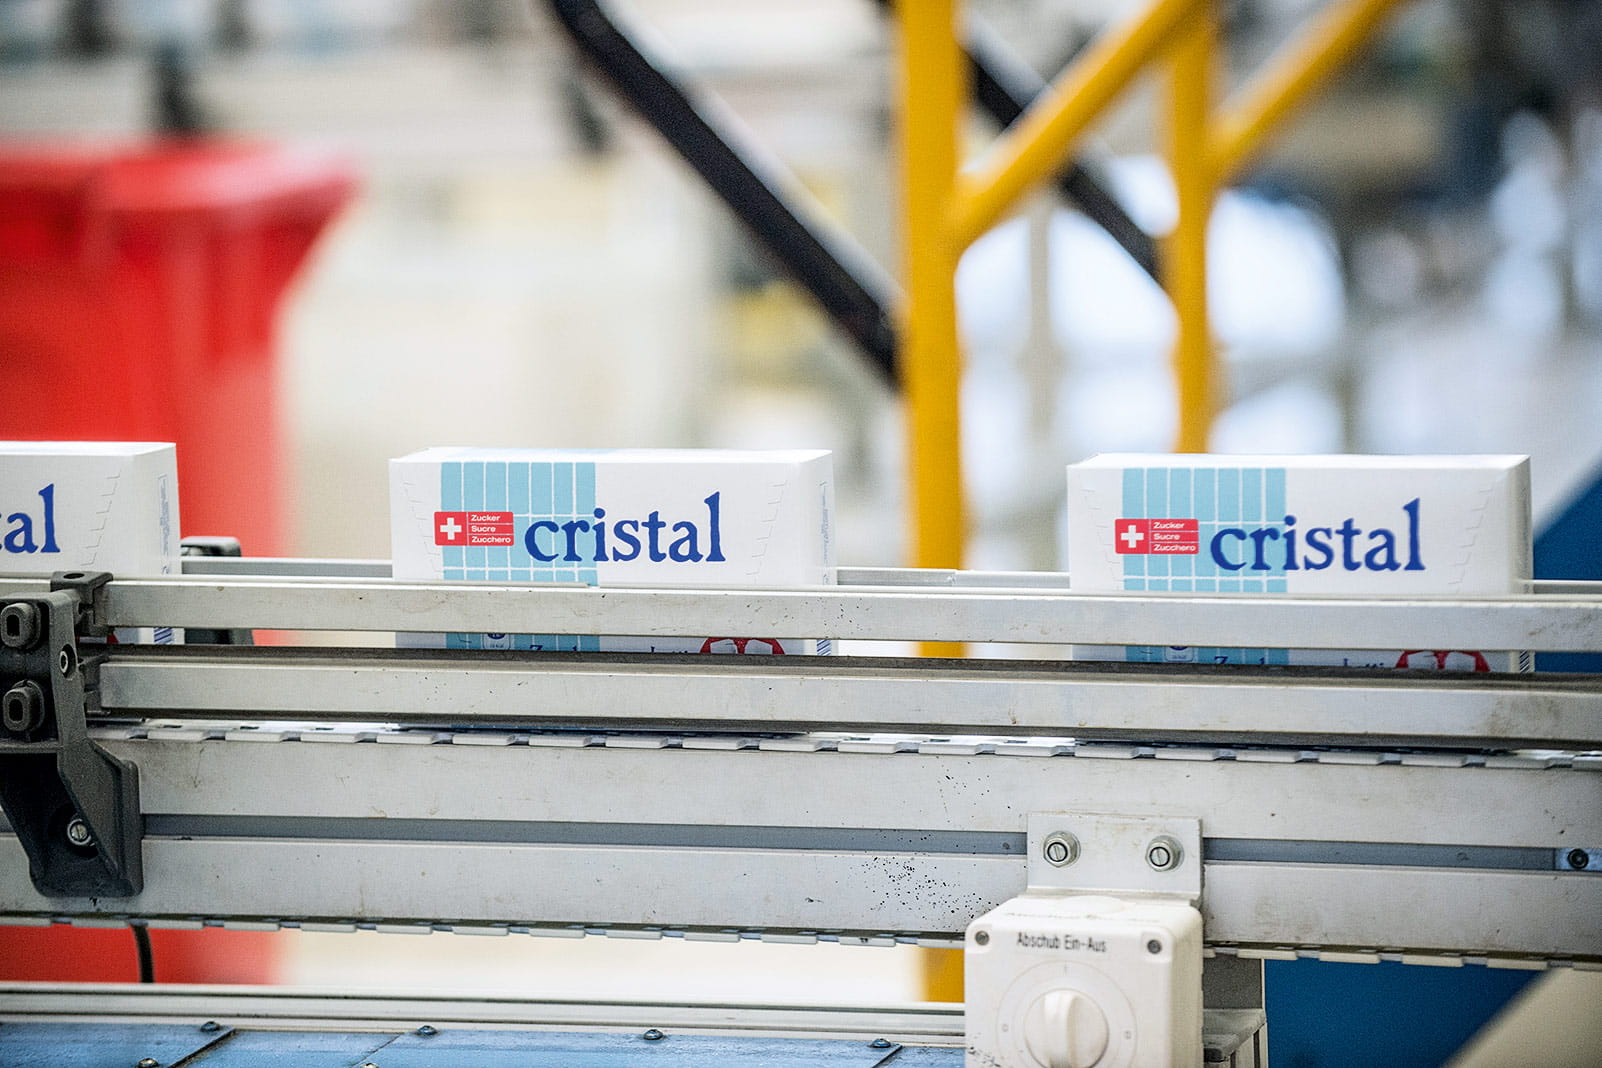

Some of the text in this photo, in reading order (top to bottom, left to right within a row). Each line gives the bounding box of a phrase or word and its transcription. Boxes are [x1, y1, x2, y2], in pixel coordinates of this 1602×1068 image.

[0, 483, 61, 554] al
[524, 491, 726, 562] cristal
[1210, 497, 1426, 571] cristal
[1016, 931, 1106, 953] Abschub Ein-Aus
